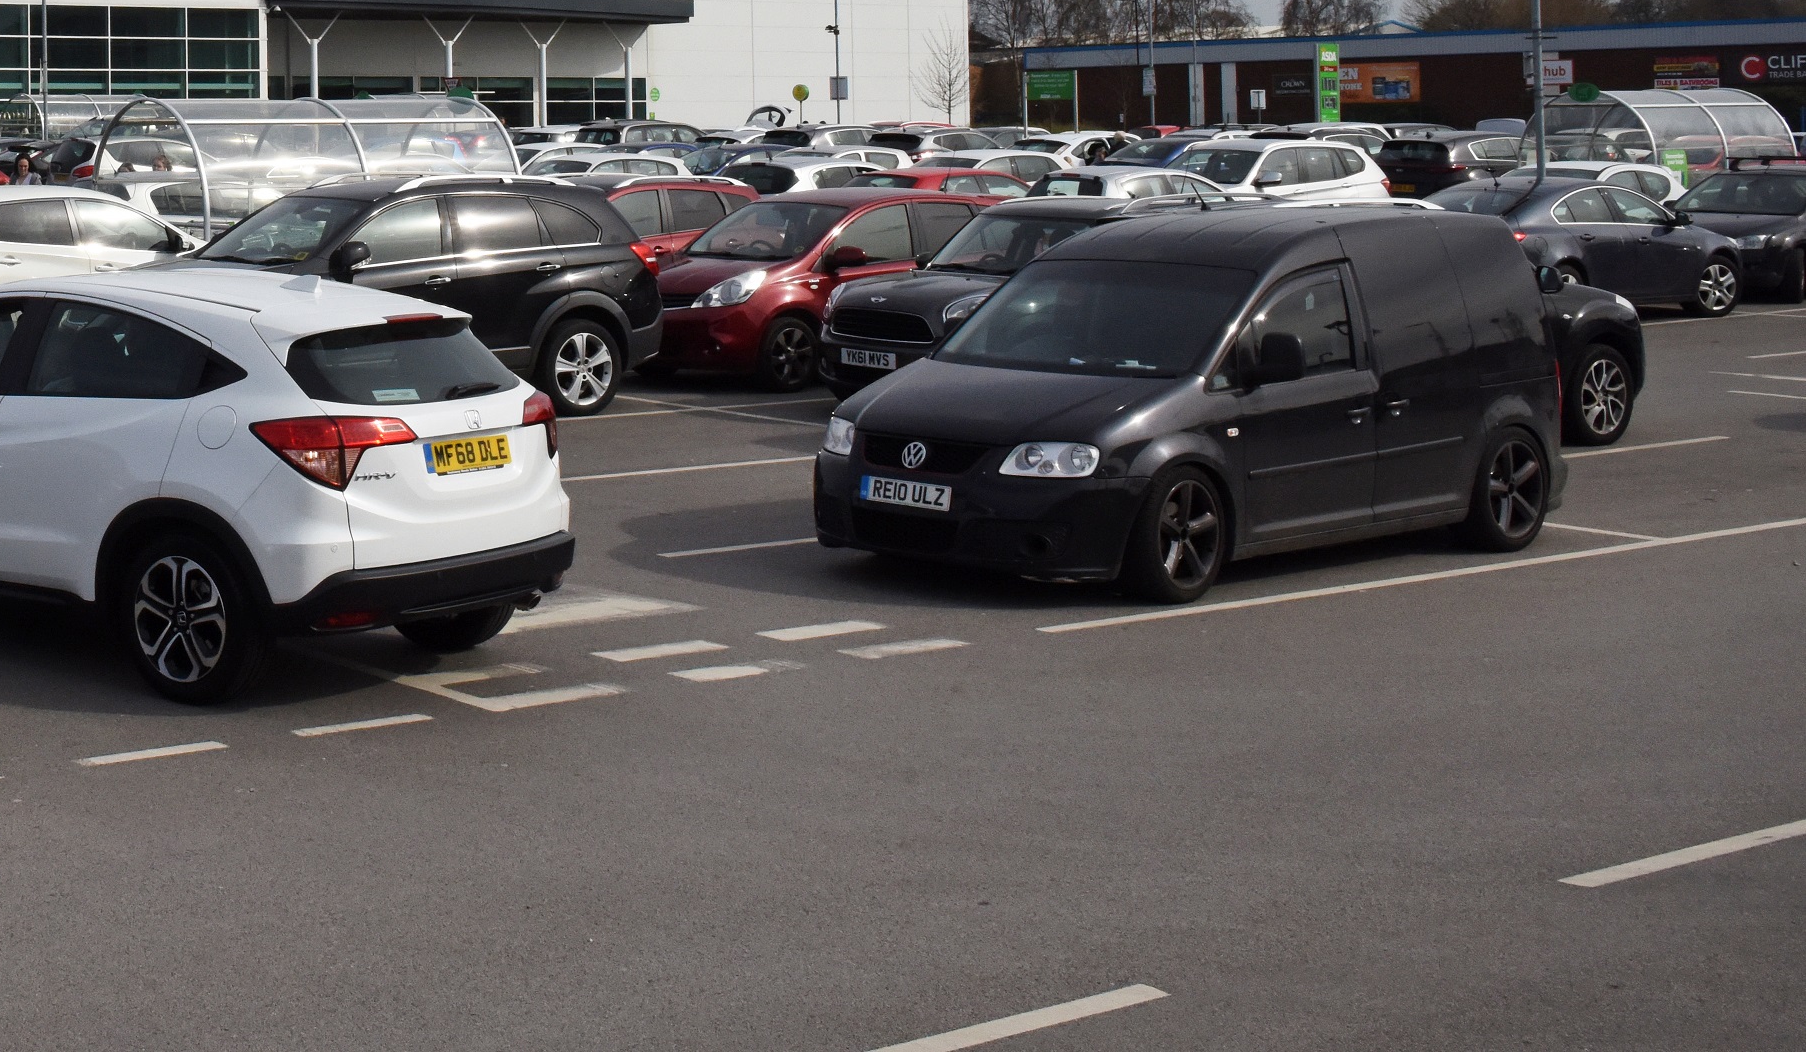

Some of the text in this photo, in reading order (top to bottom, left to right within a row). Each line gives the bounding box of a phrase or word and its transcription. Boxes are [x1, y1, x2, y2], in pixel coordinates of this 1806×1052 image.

[1321, 51, 1337, 61] ASDA
[1544, 66, 1566, 76] hub
[1768, 71, 1794, 79] TRADE
[846, 350, 890, 367] YK61 MVS
[434, 438, 508, 467] MF68 DLE
[873, 479, 946, 507] RE10 ULZ
